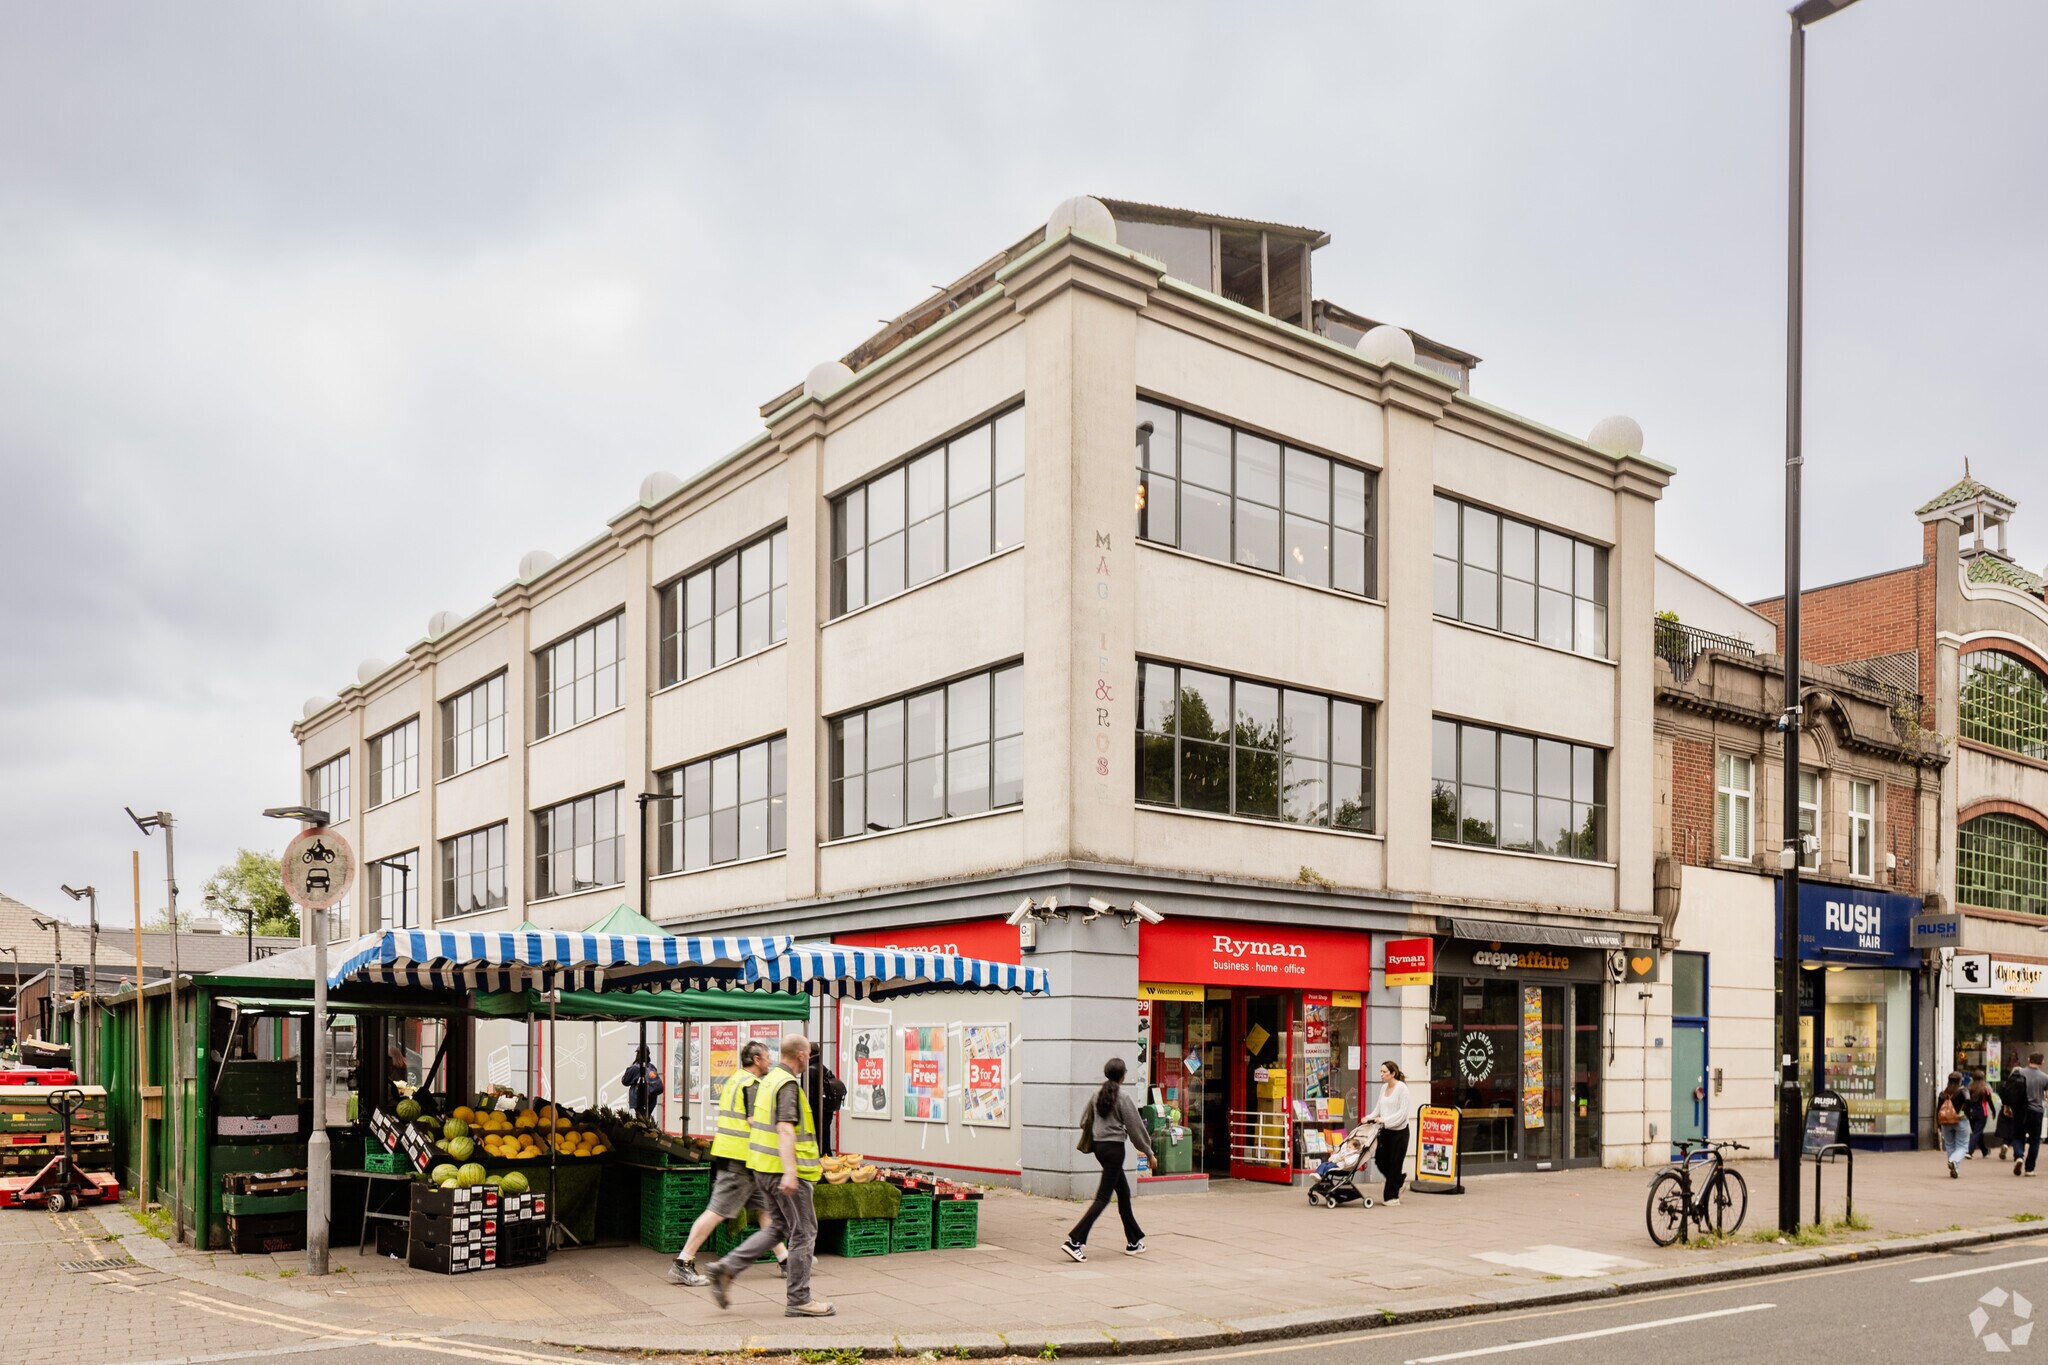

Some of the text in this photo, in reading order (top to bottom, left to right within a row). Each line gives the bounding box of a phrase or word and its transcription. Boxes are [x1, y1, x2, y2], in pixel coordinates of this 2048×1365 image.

[1825, 901, 1881, 935] RUSH
[1917, 922, 1956, 935] RUSH
[1212, 935, 1307, 957] Ryman
[1859, 935, 1881, 949] HAIR
[1213, 959, 1305, 974] business home office
[1389, 955, 1425, 965] Ryman
[1307, 1026, 1314, 1038] 3
[1321, 1026, 1328, 1038] 2
[866, 1060, 876, 1069] Only
[860, 1068, 881, 1080] £9.99
[913, 1068, 936, 1084] Free
[970, 1065, 1000, 1083] 3 for 2
[1814, 1097, 1837, 1106] RUSH
